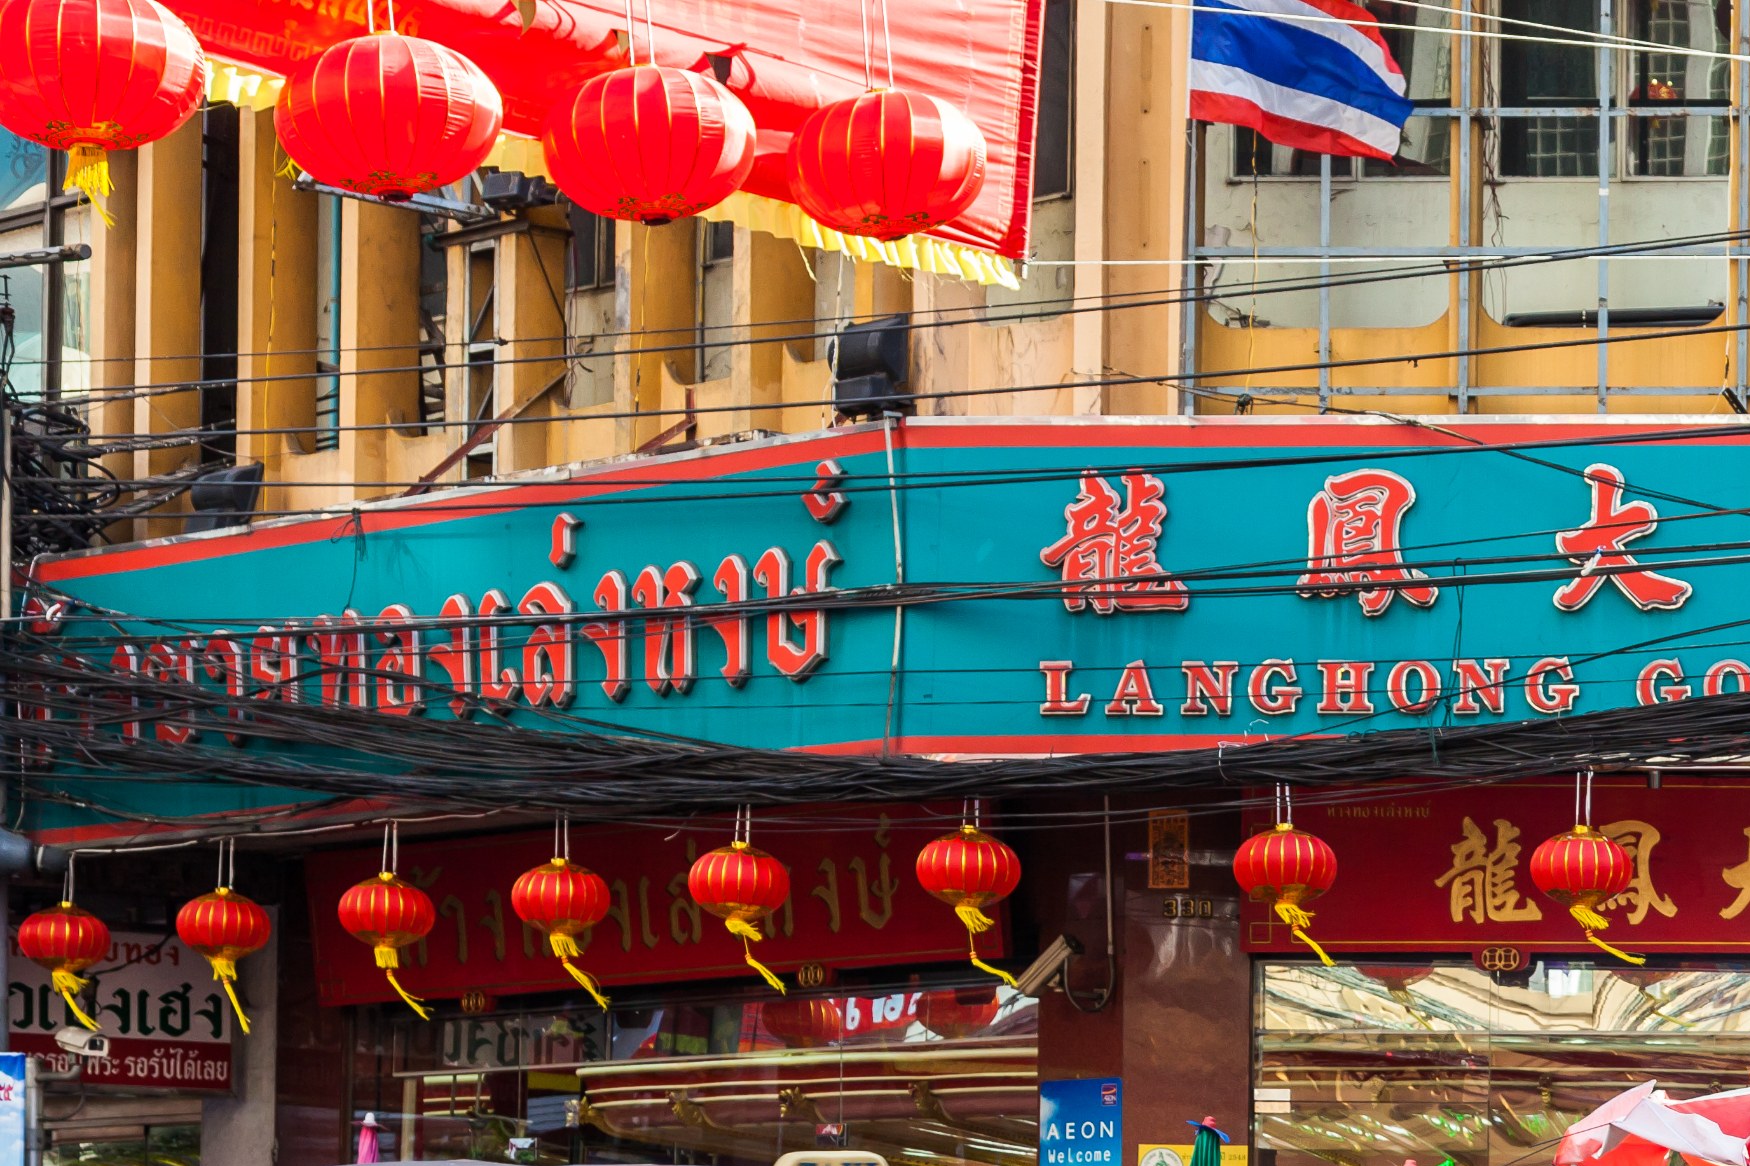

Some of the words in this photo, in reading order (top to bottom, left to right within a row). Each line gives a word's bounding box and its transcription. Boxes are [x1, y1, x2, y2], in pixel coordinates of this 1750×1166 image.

[1039, 656, 1581, 718] LANGHONG
[1163, 900, 1213, 918] 330
[1047, 1121, 1114, 1140] AEON
[1048, 1148, 1111, 1164] Welcome
